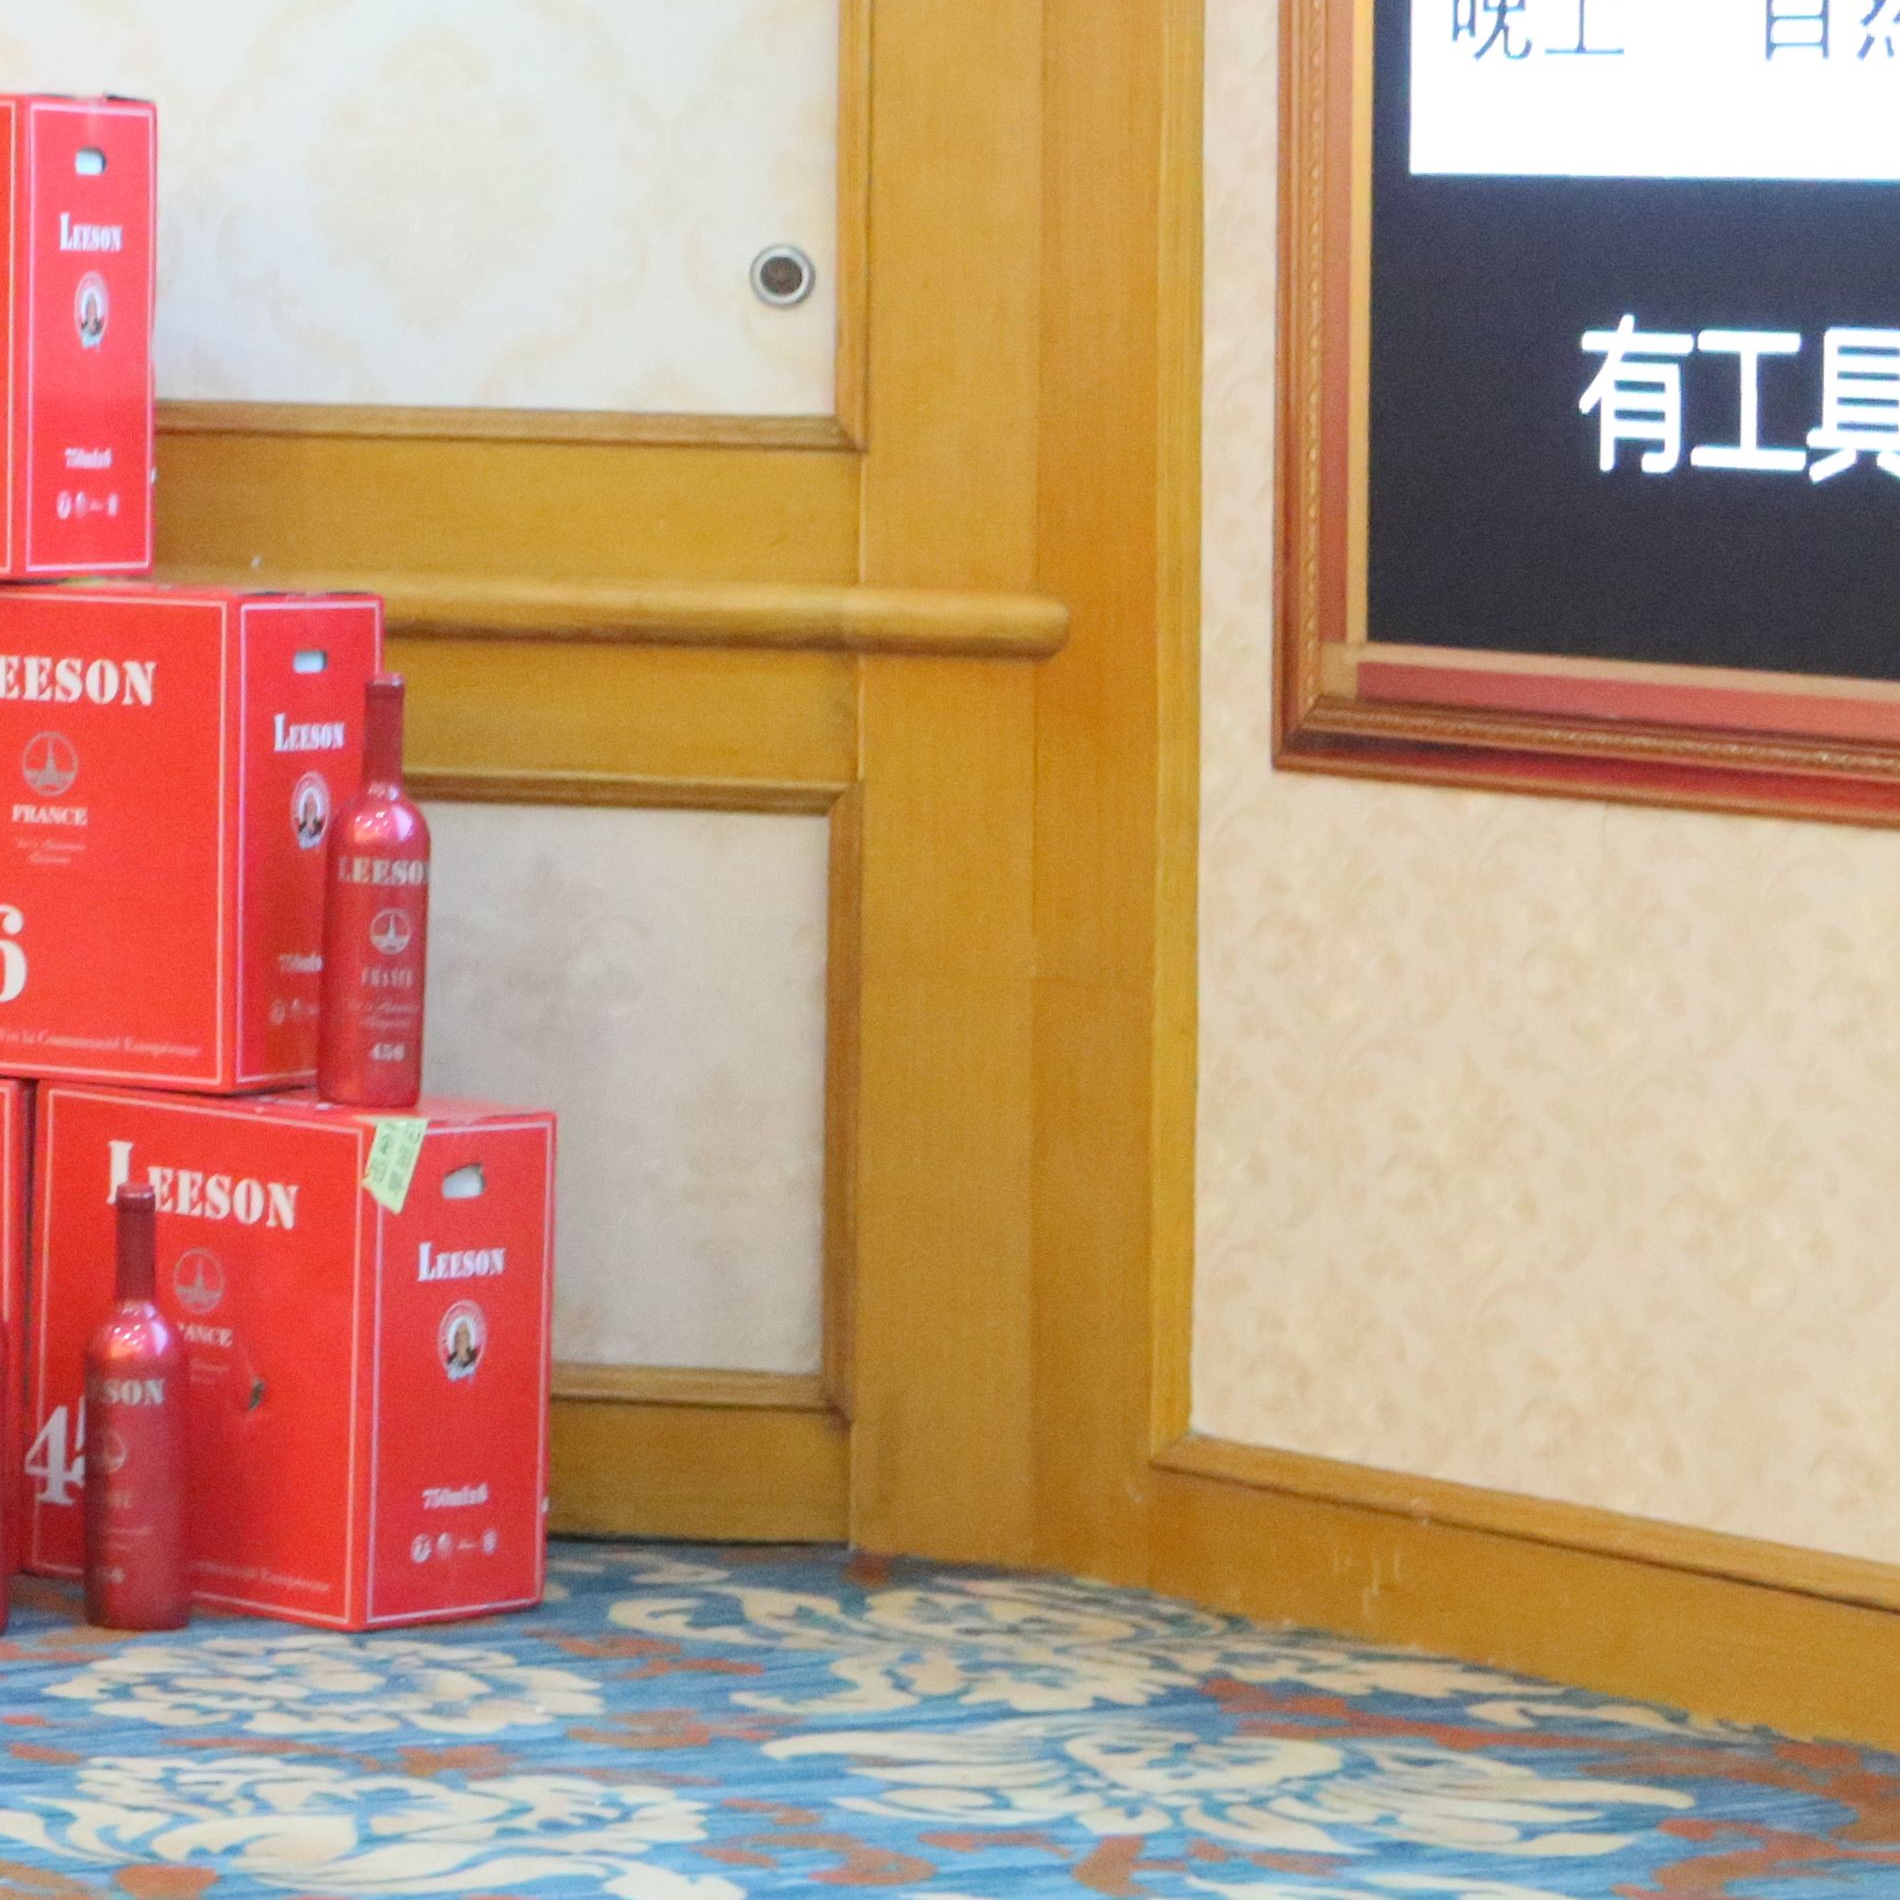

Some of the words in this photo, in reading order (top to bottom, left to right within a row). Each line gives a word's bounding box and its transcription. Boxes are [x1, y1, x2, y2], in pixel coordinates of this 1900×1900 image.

[60, 212, 122, 251] LEESON
[1579, 314, 1900, 484] 有工具
[274, 713, 344, 752] LEESON
[12, 804, 87, 826] FRANCE
[418, 1242, 505, 1281] LEESON
